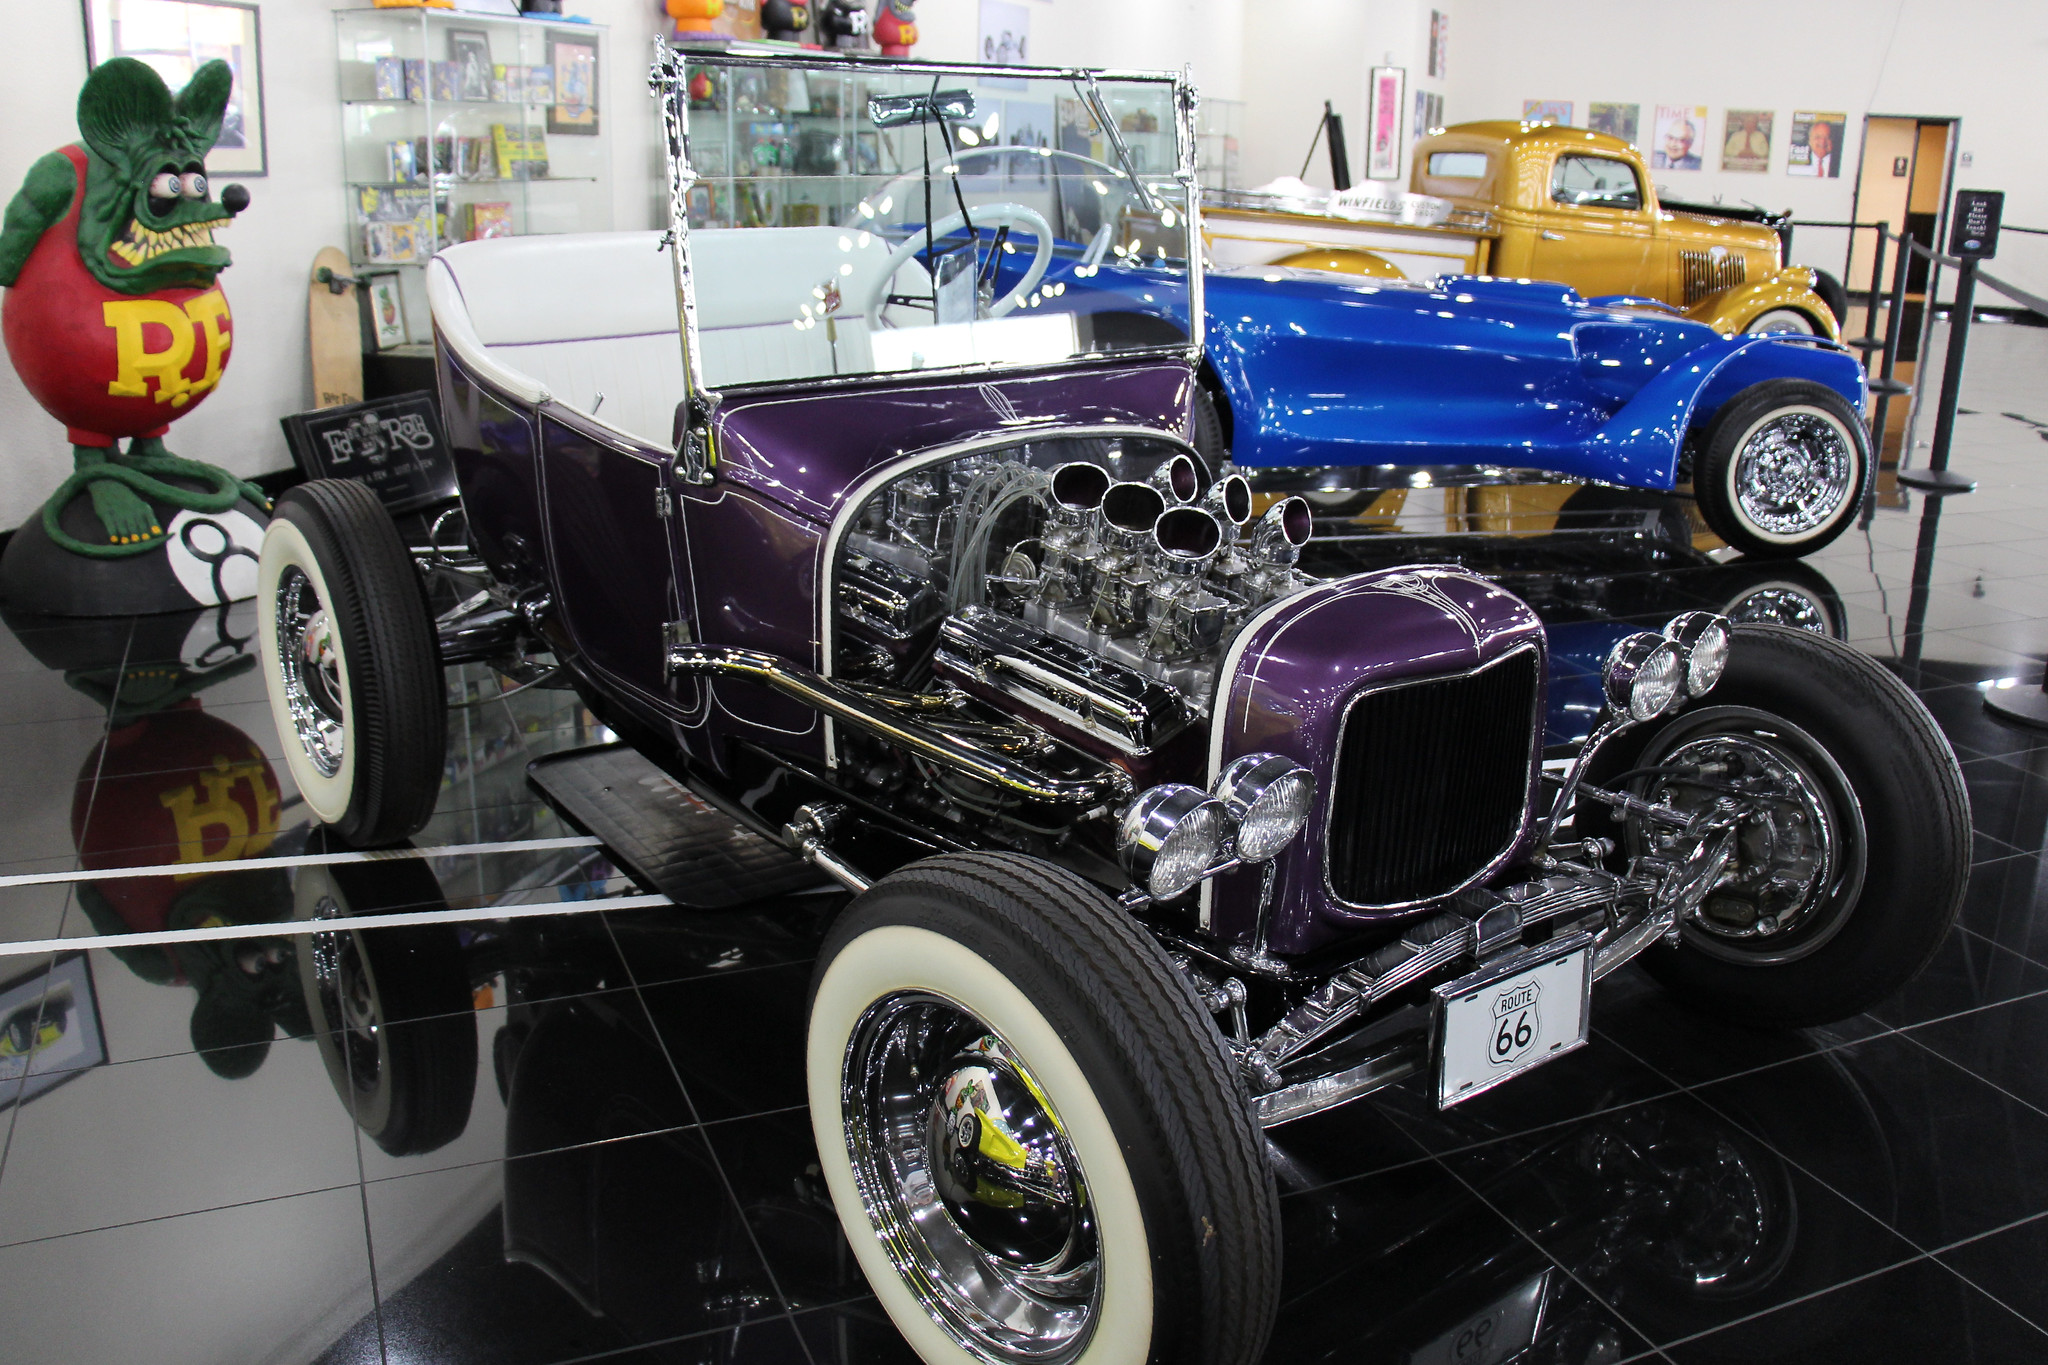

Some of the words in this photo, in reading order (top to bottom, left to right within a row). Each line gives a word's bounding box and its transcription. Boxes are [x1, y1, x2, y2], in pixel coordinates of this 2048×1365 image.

[1655, 106, 1691, 120] TIME
[1501, 988, 1532, 1013] ROUTE
[1496, 1010, 1532, 1056] 66
